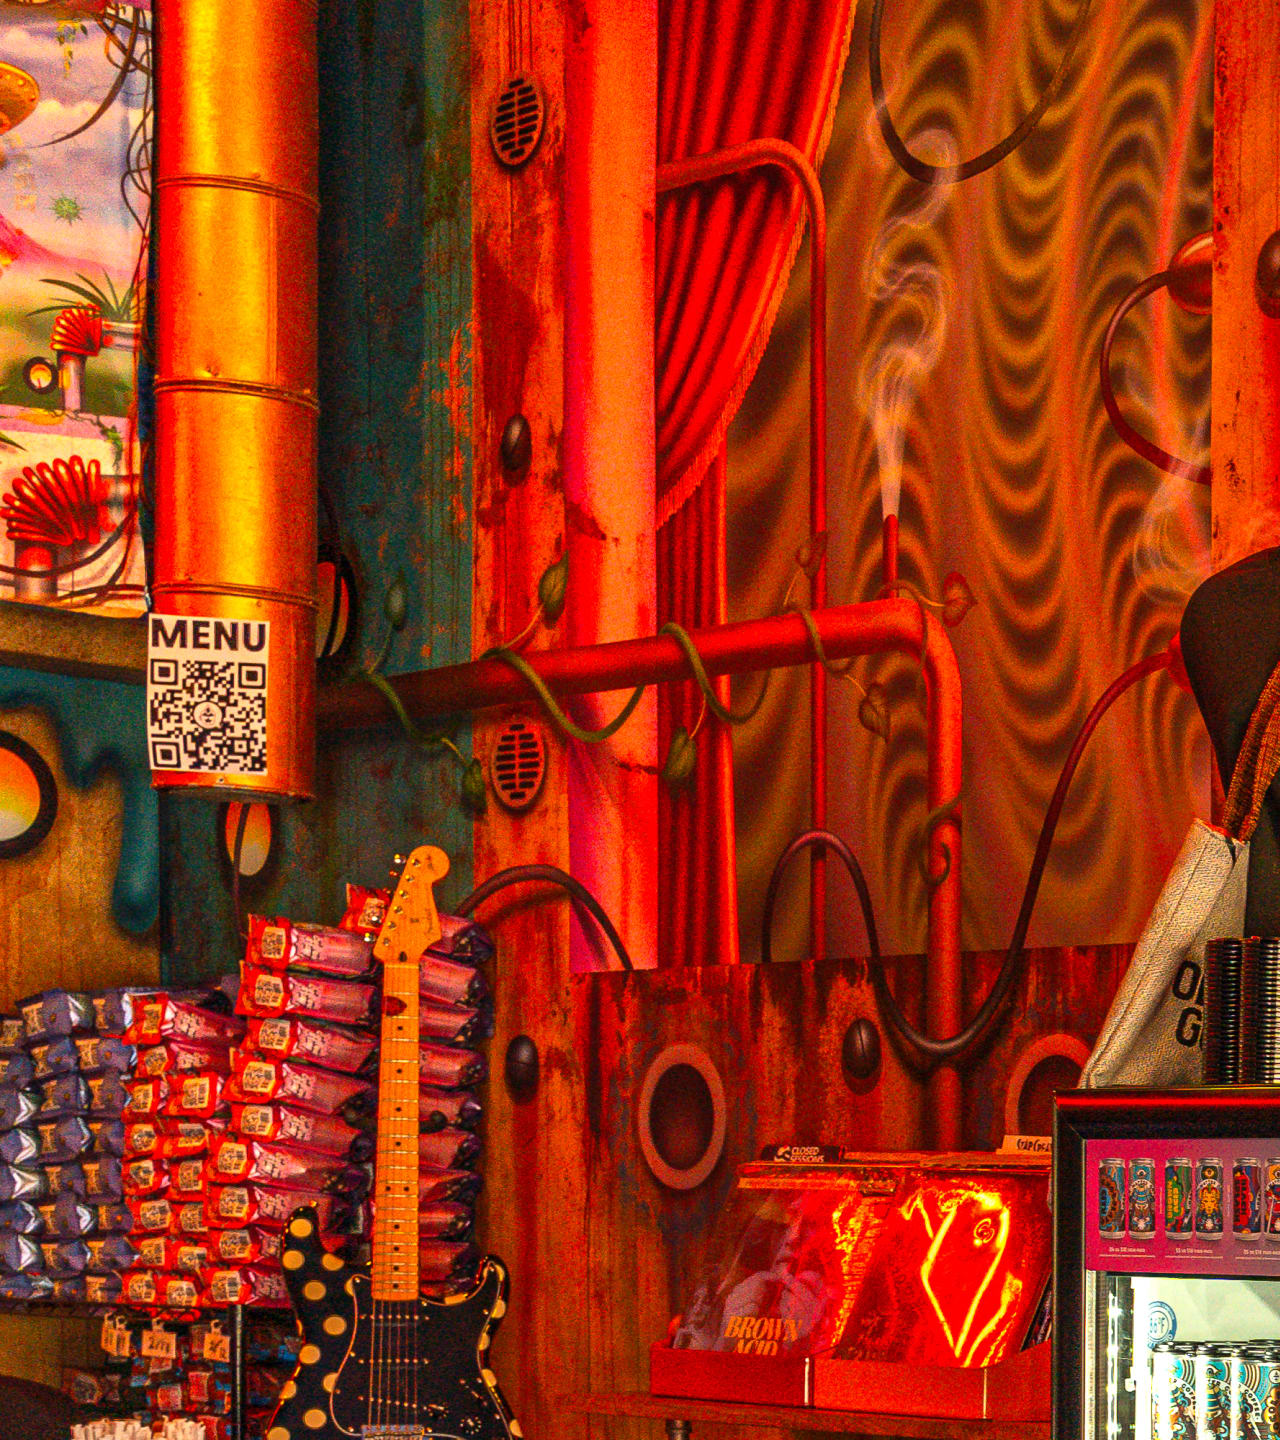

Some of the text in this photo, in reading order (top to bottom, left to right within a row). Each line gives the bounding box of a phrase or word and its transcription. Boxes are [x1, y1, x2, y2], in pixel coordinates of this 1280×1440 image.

[150, 618, 267, 653] MENU
[791, 1146, 819, 1155] CLOSED
[726, 1316, 802, 1342] BROWN
